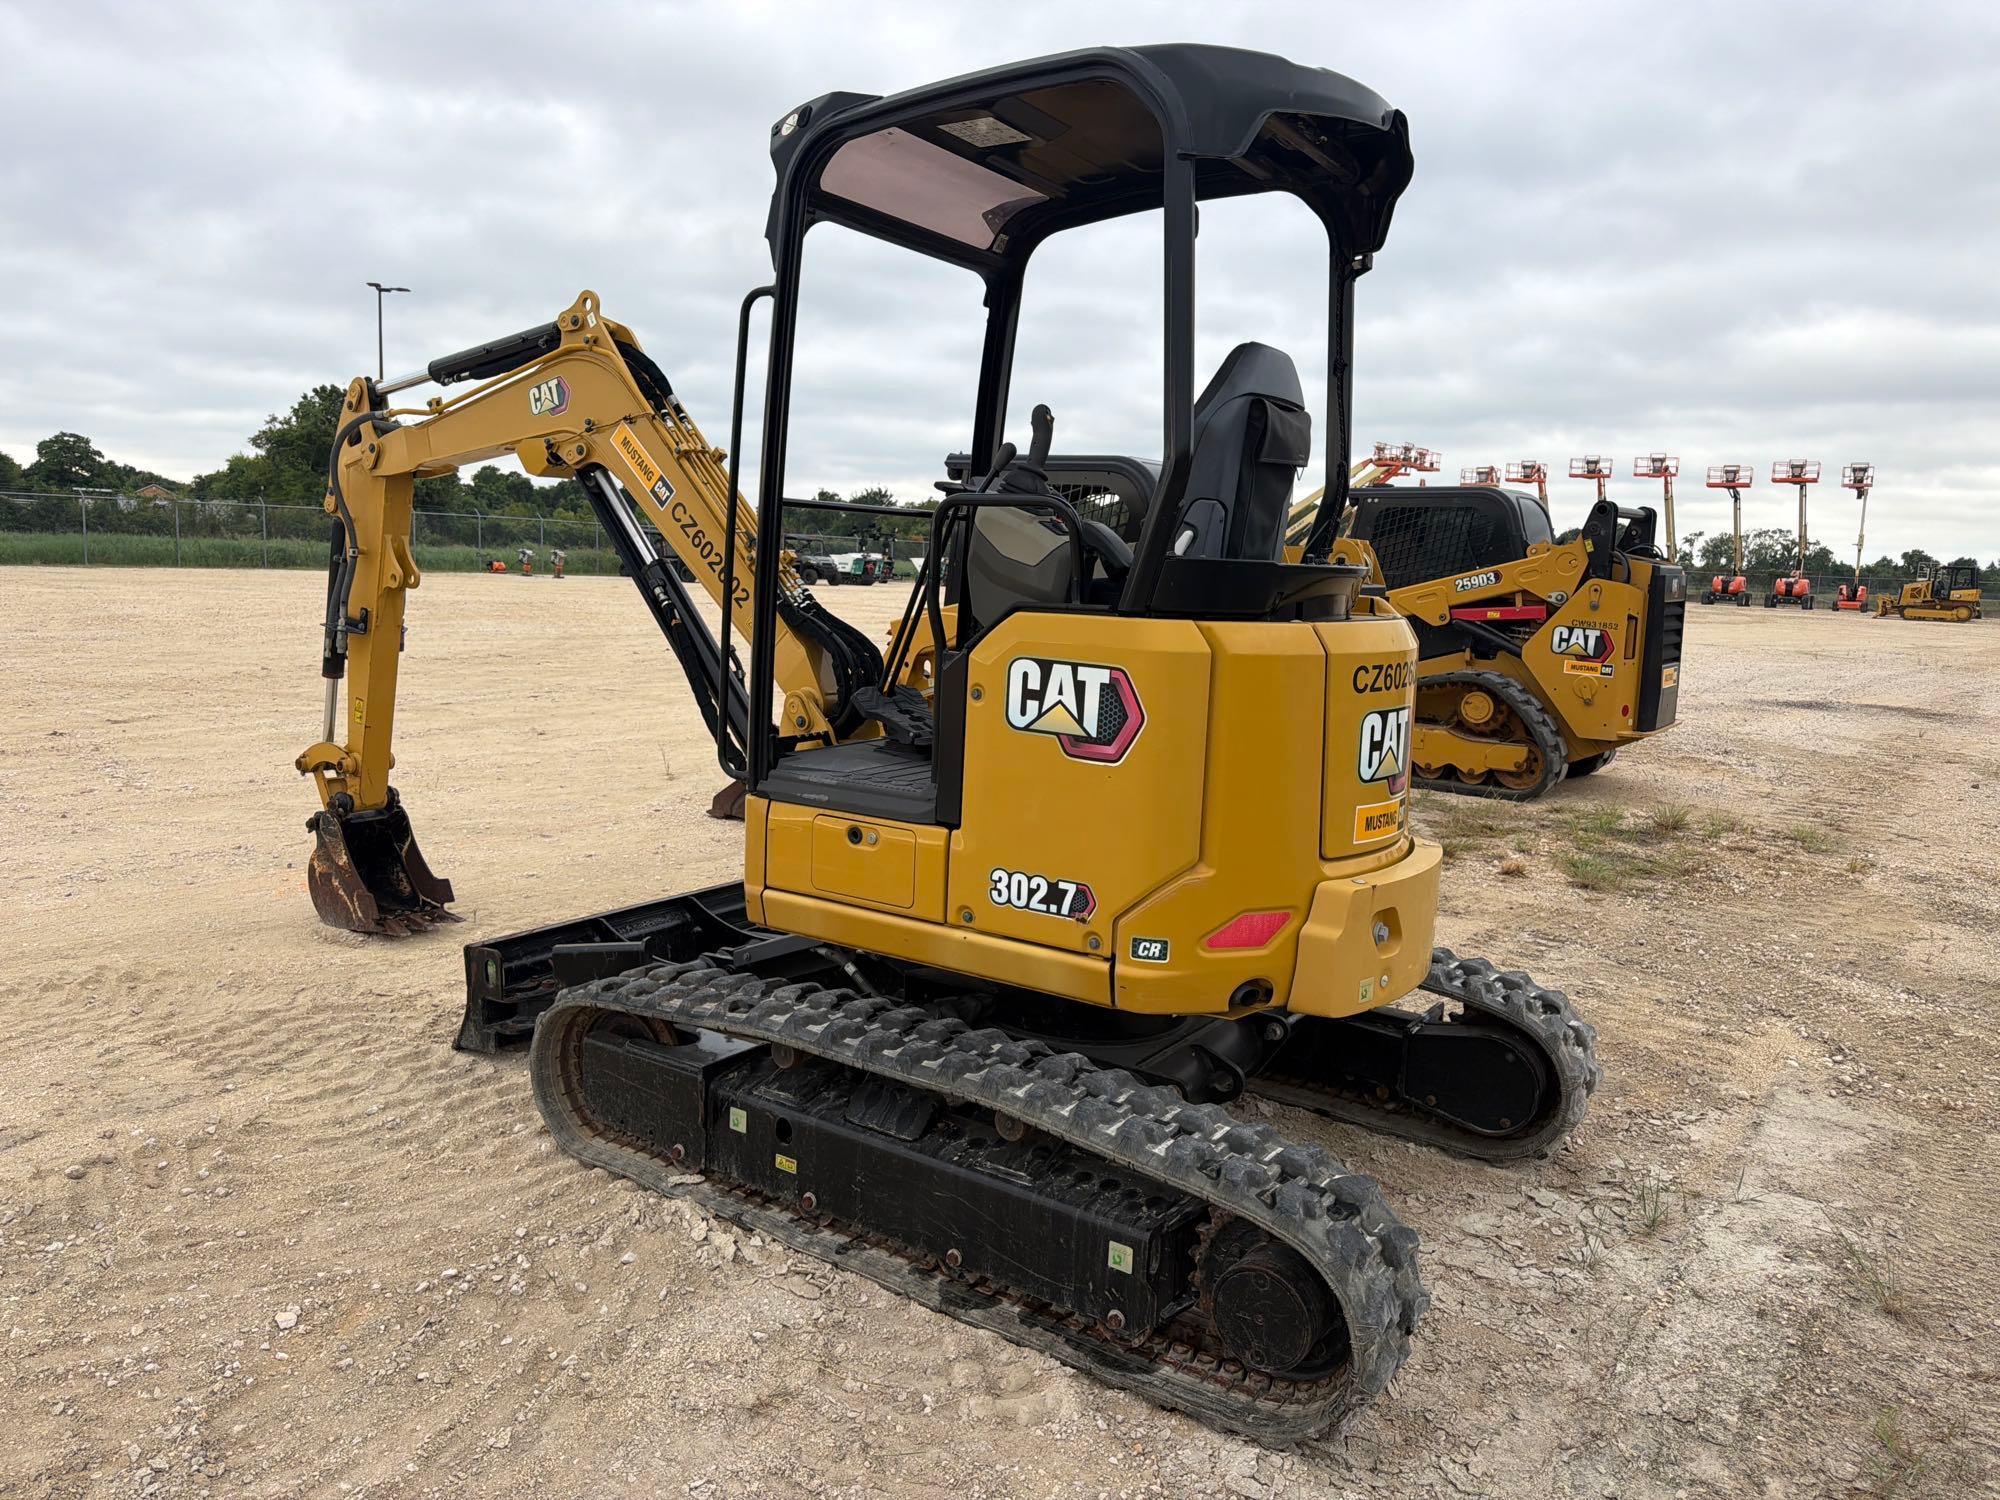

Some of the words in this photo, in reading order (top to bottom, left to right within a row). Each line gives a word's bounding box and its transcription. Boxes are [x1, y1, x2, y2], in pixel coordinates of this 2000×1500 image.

[529, 378, 560, 415] CAT
[620, 435, 655, 482] MUSTANG
[654, 481, 670, 502] CAT
[1455, 572, 1496, 592] 259D3
[1552, 626, 1601, 657] CAT
[1570, 664, 1598, 673] MUSTANG
[1601, 666, 1613, 674] CAT
[1009, 658, 1113, 739] CAT
[1359, 709, 1409, 782] CAT
[1365, 810, 1397, 832] MUSTANG
[990, 868, 1078, 916] 302.7
[1137, 941, 1162, 957] CR
